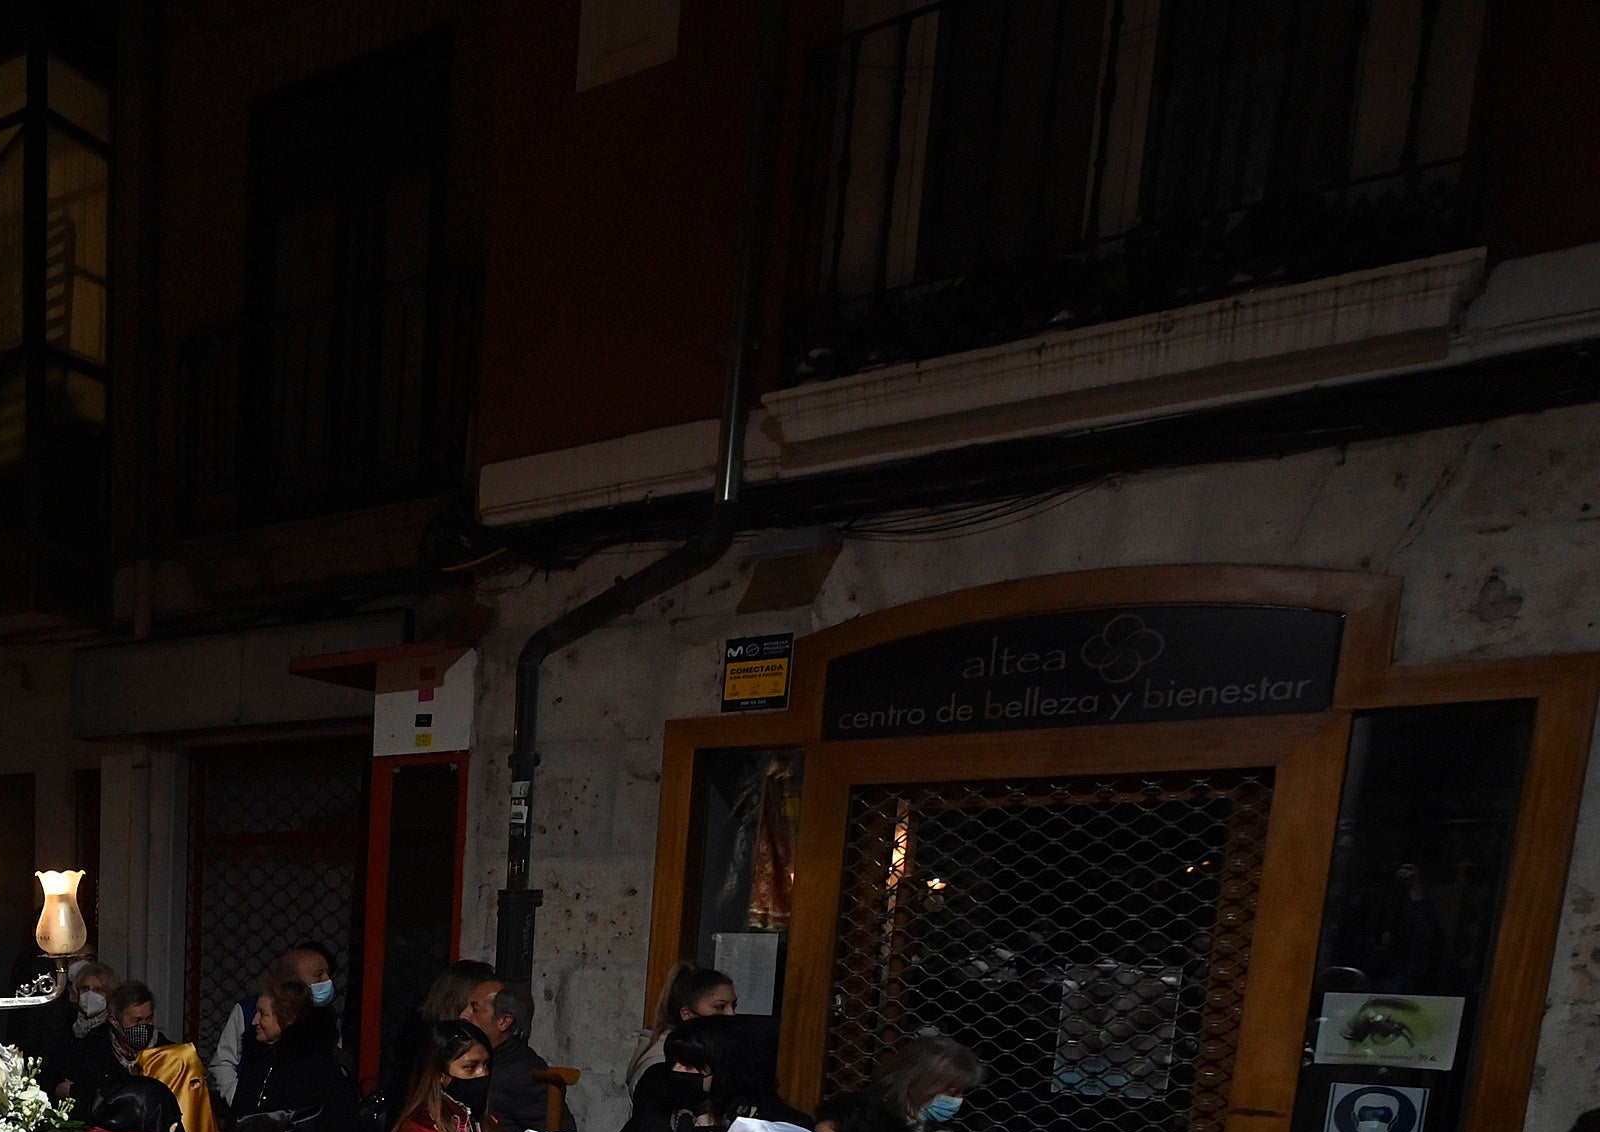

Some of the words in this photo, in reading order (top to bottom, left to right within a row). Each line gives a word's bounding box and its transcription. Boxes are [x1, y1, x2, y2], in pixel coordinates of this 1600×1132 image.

[730, 664, 783, 675] CONECTADA
[961, 636, 1067, 681] altea
[838, 702, 925, 730] centro
[936, 693, 975, 724] de
[985, 686, 1099, 721] belleza
[1108, 690, 1133, 720] y
[1145, 677, 1312, 710] bienestar
